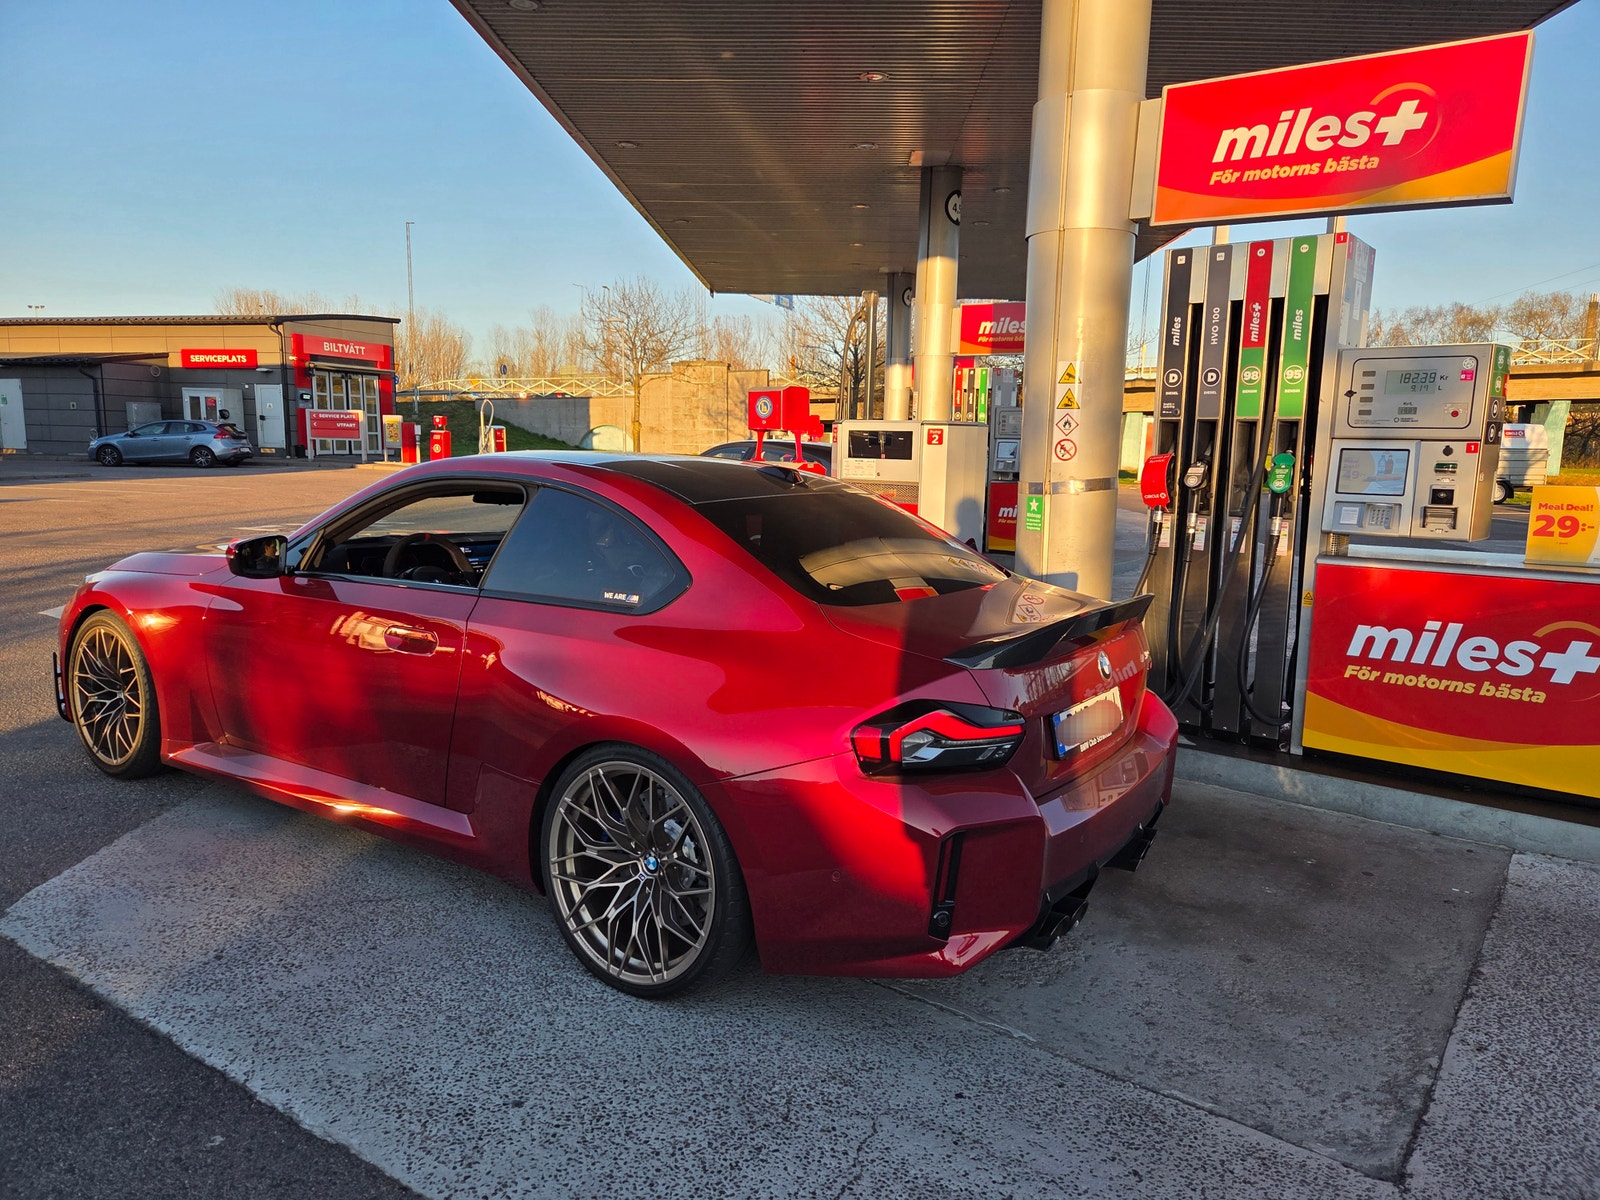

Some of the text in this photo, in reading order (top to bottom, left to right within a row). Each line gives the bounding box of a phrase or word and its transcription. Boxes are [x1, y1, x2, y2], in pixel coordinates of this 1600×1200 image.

[1209, 155, 1379, 185] För motorns bästa
[1210, 307, 1220, 345] HVO 100
[1292, 309, 1303, 341] miles
[1171, 316, 1182, 346] miles
[323, 342, 366, 355] BILTVÄTT
[190, 355, 247, 363] SERVICEPLATS
[1169, 373, 1178, 383] D
[1207, 372, 1217, 382] D
[1243, 370, 1259, 381] 98
[1285, 369, 1302, 380] 95
[932, 434, 939, 444] 2
[998, 505, 1018, 518] mi
[1538, 502, 1594, 511] Meal Deal!
[604, 591, 614, 599] WE
[1344, 664, 1546, 703] För motorns bästa
